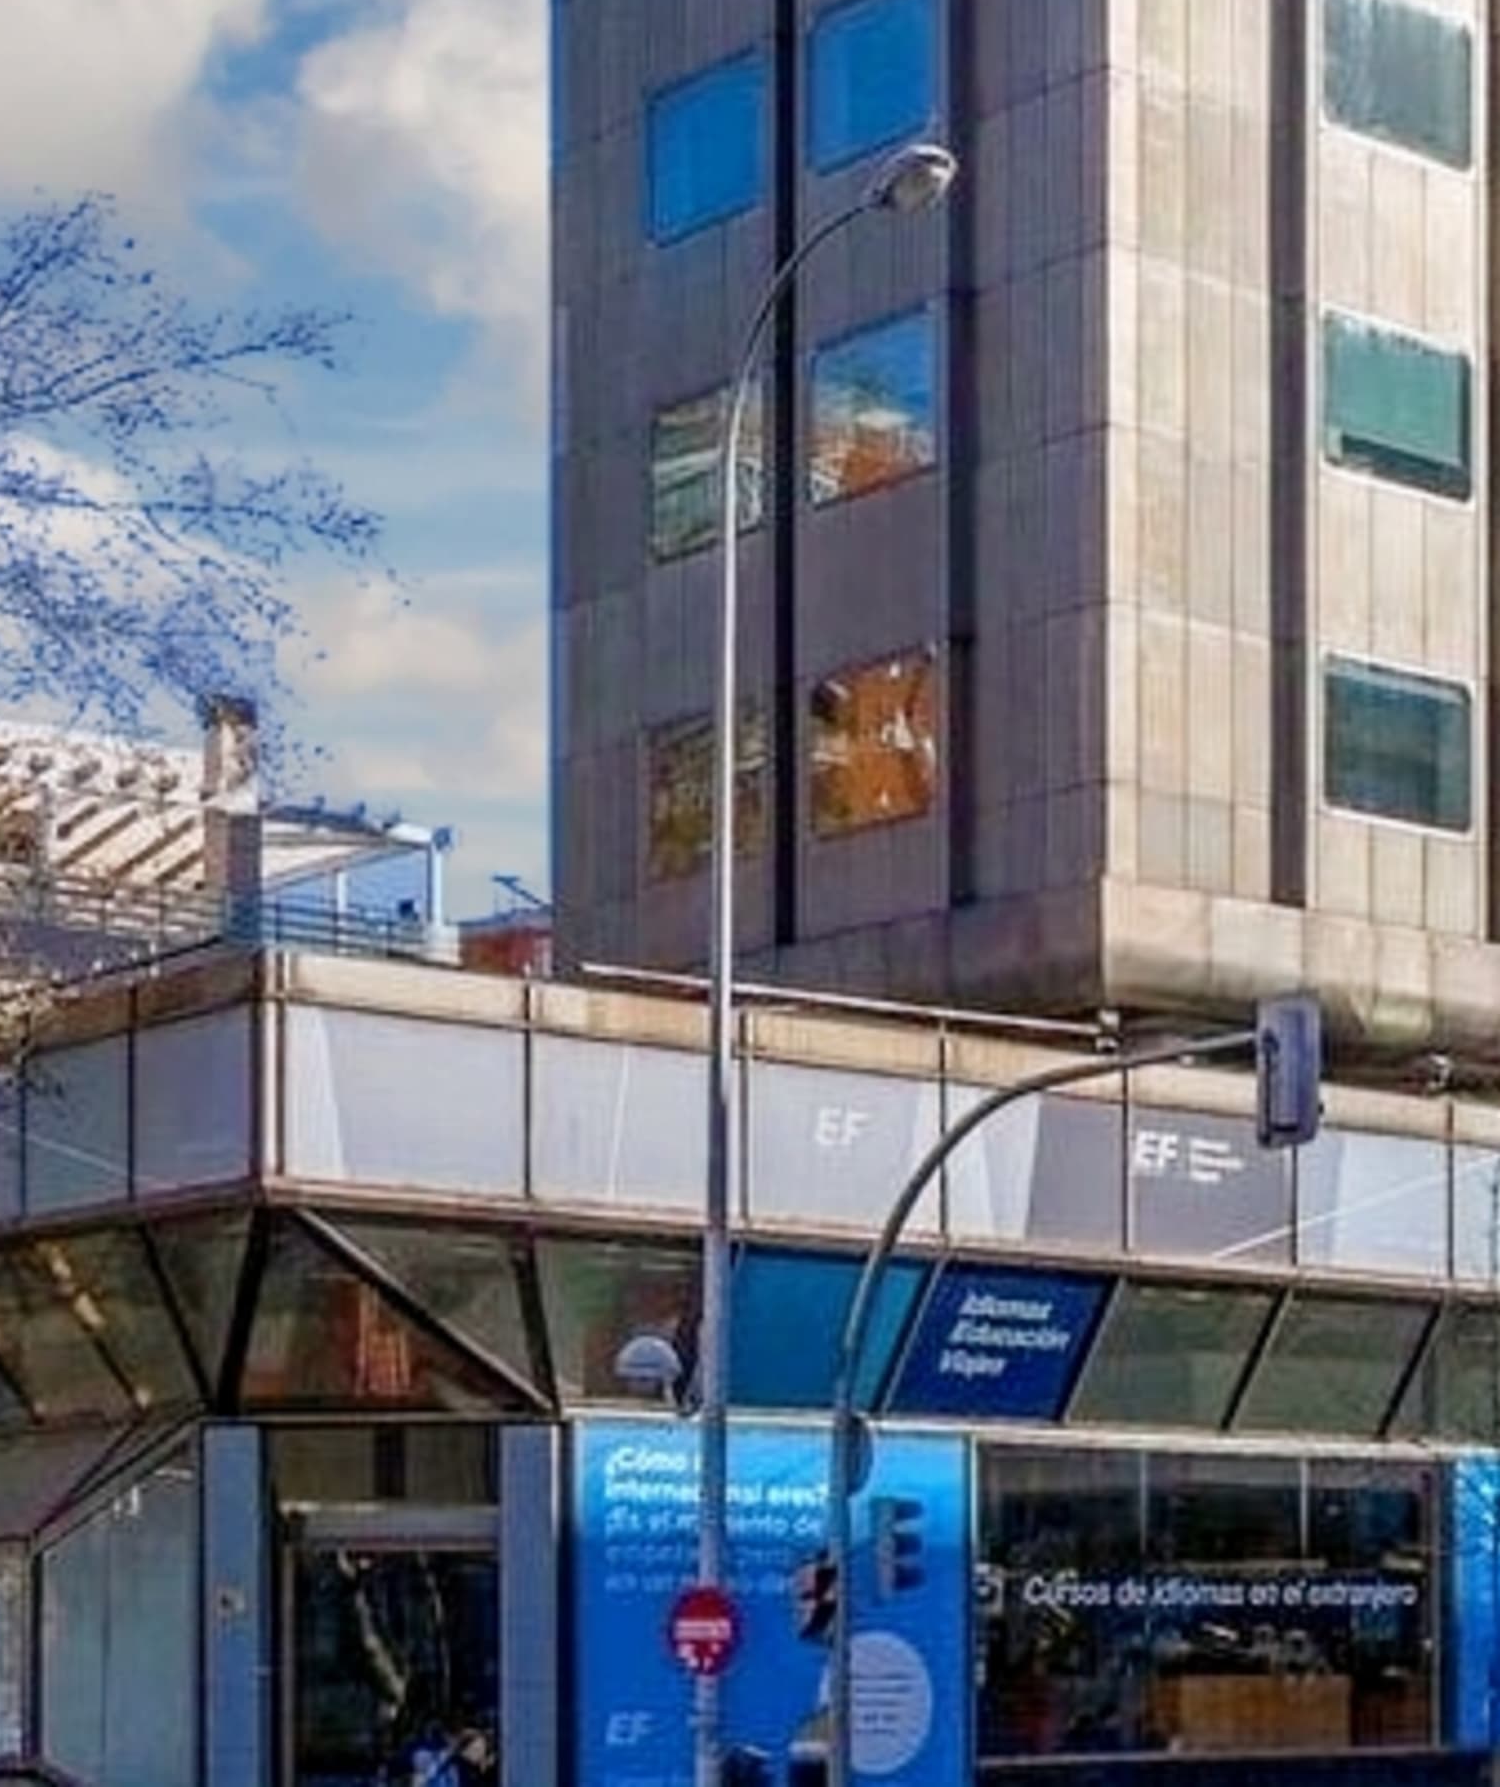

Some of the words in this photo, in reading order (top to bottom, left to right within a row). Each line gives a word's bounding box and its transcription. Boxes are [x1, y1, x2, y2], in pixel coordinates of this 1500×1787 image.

[814, 1108, 865, 1146] EF
[1133, 1130, 1180, 1171] EF
[949, 1320, 1071, 1350] Educación
[1024, 1575, 1110, 1606] Cursos
[1116, 1578, 1146, 1606] de
[1150, 1577, 1244, 1606] idiomas
[1249, 1584, 1278, 1606] en
[1283, 1577, 1306, 1606] el
[1308, 1578, 1417, 1610] extranjero
[605, 1712, 652, 1746] EF
